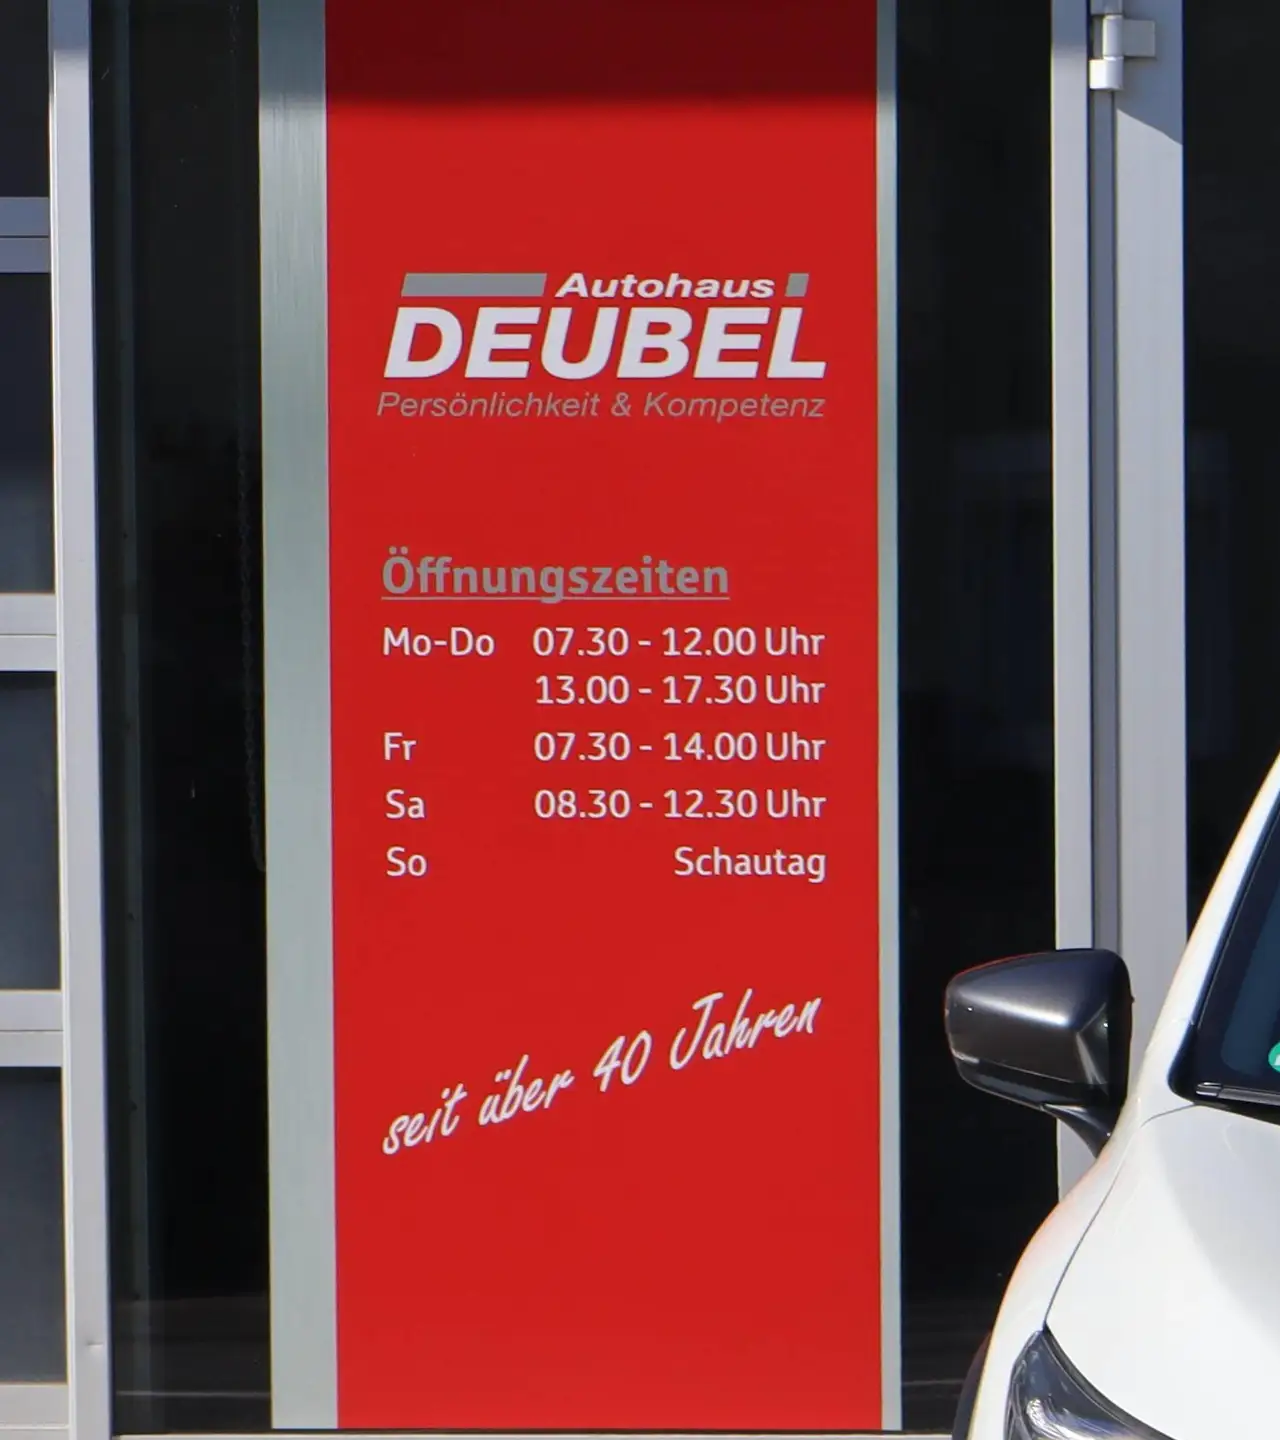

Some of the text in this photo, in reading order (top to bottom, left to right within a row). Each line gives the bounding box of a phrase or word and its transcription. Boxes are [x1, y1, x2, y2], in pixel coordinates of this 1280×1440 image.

[555, 272, 776, 299] Autohaus
[383, 306, 828, 380] DEUBEL
[376, 391, 826, 424] Persönlichkeit & Kompetenz
[381, 546, 730, 604] Öffnungszeiten
[382, 626, 495, 657] Mo-Do
[532, 626, 630, 657] 07.30
[661, 626, 757, 657] 12.00
[764, 626, 826, 657] Uhr
[535, 674, 630, 705] 13.00
[662, 674, 758, 705] 17.30
[765, 674, 826, 705] Uhr
[383, 731, 417, 761] Fr
[533, 731, 631, 762] 07.30
[663, 731, 758, 761] 14.00
[765, 731, 827, 761] Uhr
[385, 789, 425, 819] Sa
[534, 788, 631, 819] 08.30
[663, 788, 758, 819] 12.30
[766, 788, 828, 819] Uhr
[386, 845, 827, 884] So Schautag
[382, 988, 823, 1155] seit über 40 Jahren
